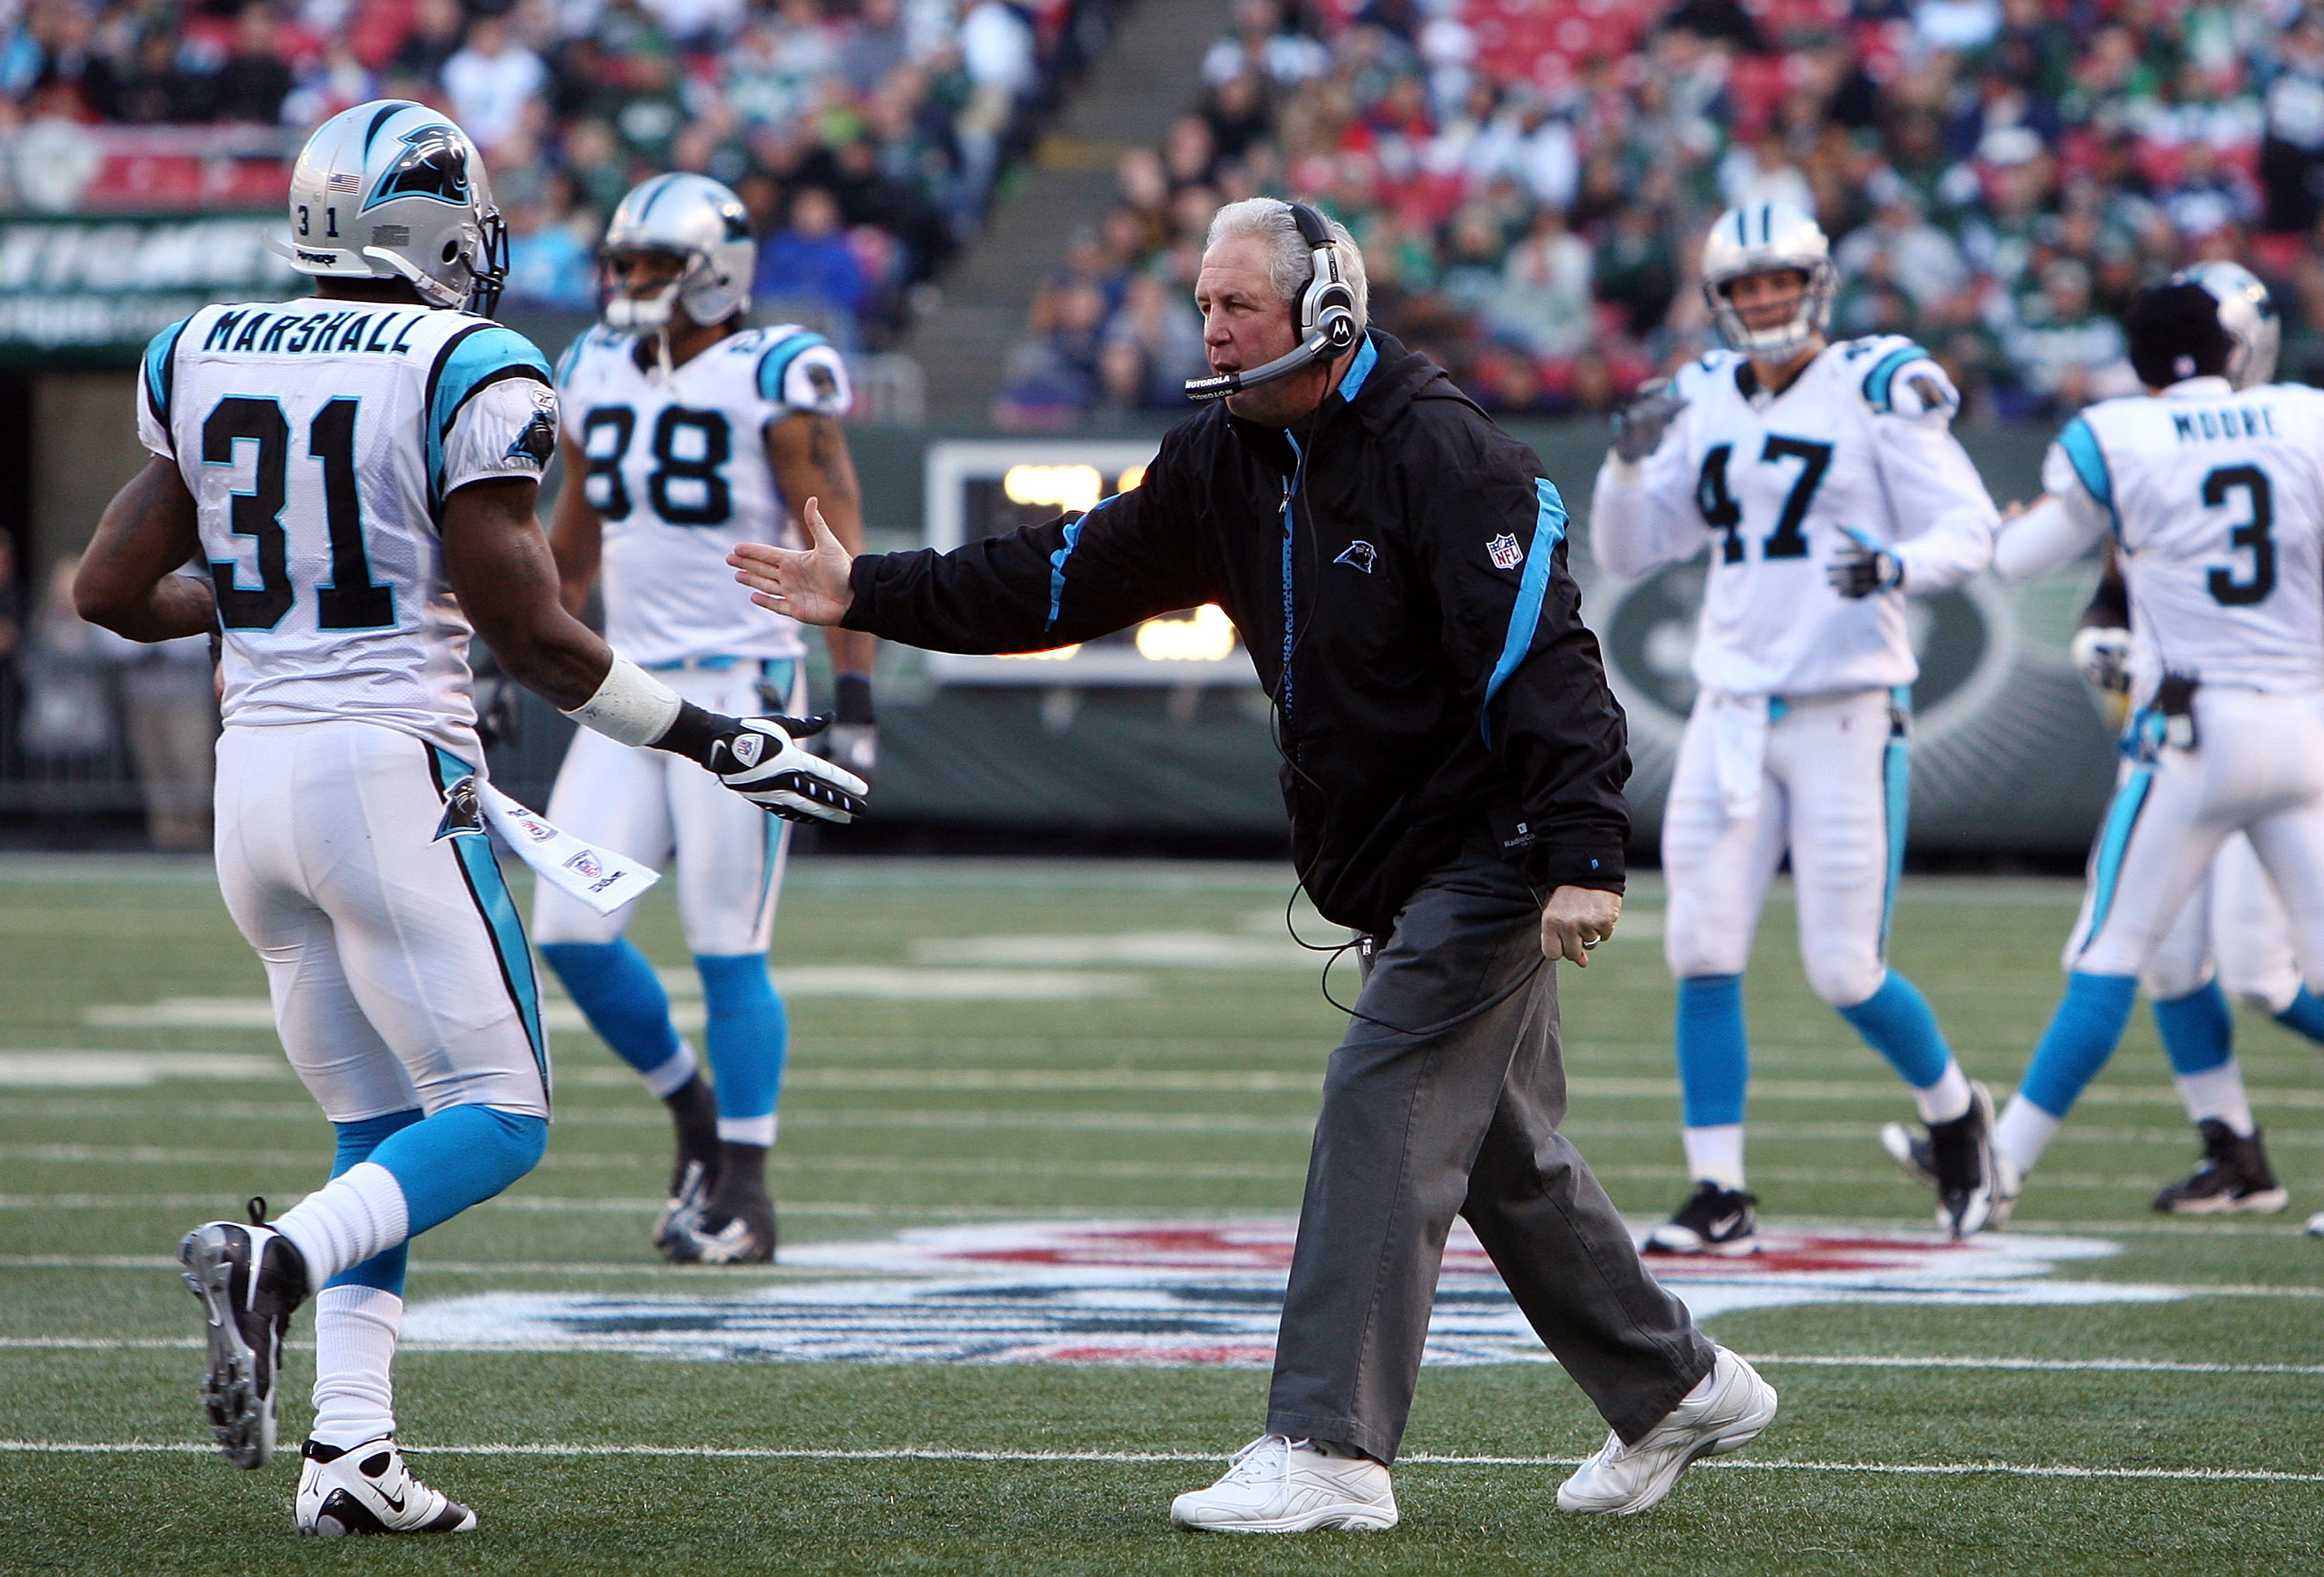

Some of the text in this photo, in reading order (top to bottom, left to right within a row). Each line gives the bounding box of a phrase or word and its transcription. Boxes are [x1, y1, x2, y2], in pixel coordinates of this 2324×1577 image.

[202, 309, 428, 355] MARSHALL
[1185, 376, 1230, 388] MOTOROLA
[2172, 407, 2278, 441] MOORE
[584, 404, 732, 527] 88
[1697, 431, 1834, 565] 47
[202, 394, 397, 632] 31
[2202, 462, 2277, 606] 3
[1495, 548, 1518, 565] NFL
